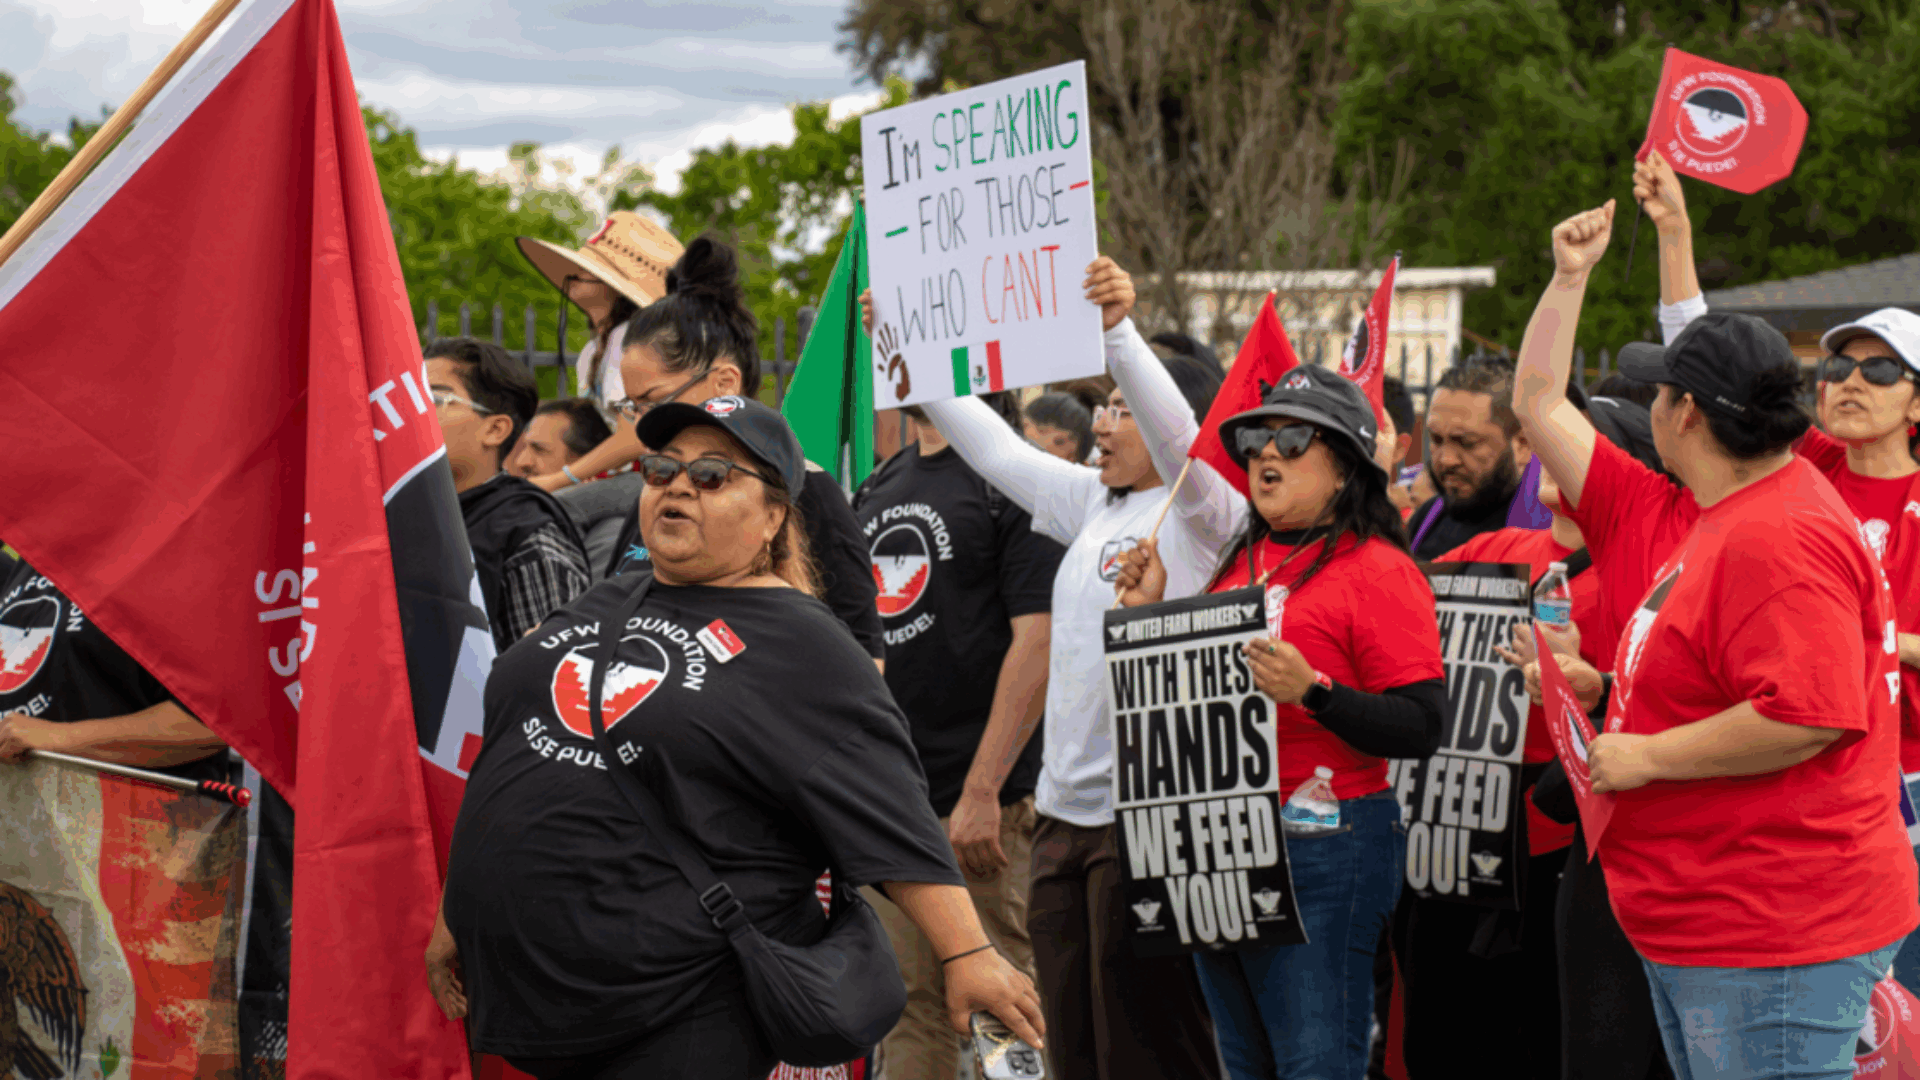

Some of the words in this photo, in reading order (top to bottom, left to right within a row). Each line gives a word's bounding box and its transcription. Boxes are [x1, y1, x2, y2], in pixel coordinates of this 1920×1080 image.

[932, 79, 1079, 171] SPEAKING
[897, 268, 967, 346] WHO
[882, 503, 954, 562] FOUNDATION
[540, 621, 601, 649] UFW
[625, 617, 707, 691] OUNDATION
[883, 612, 934, 645] UEDE!
[1127, 616, 1163, 643] UNITED
[1164, 611, 1192, 637] FARM
[1192, 603, 1242, 632] WORKERS
[1110, 652, 1179, 712] WITH
[1184, 641, 1259, 701] THES
[530, 735, 560, 758] SE
[555, 740, 638, 771] PUEE!
[1116, 694, 1272, 803] HANDS
[1421, 755, 1511, 834] FEED
[1122, 803, 1188, 880] WE
[1188, 795, 1279, 873] FEED
[1405, 822, 1470, 896] OU!
[1164, 869, 1260, 945] YOU!
